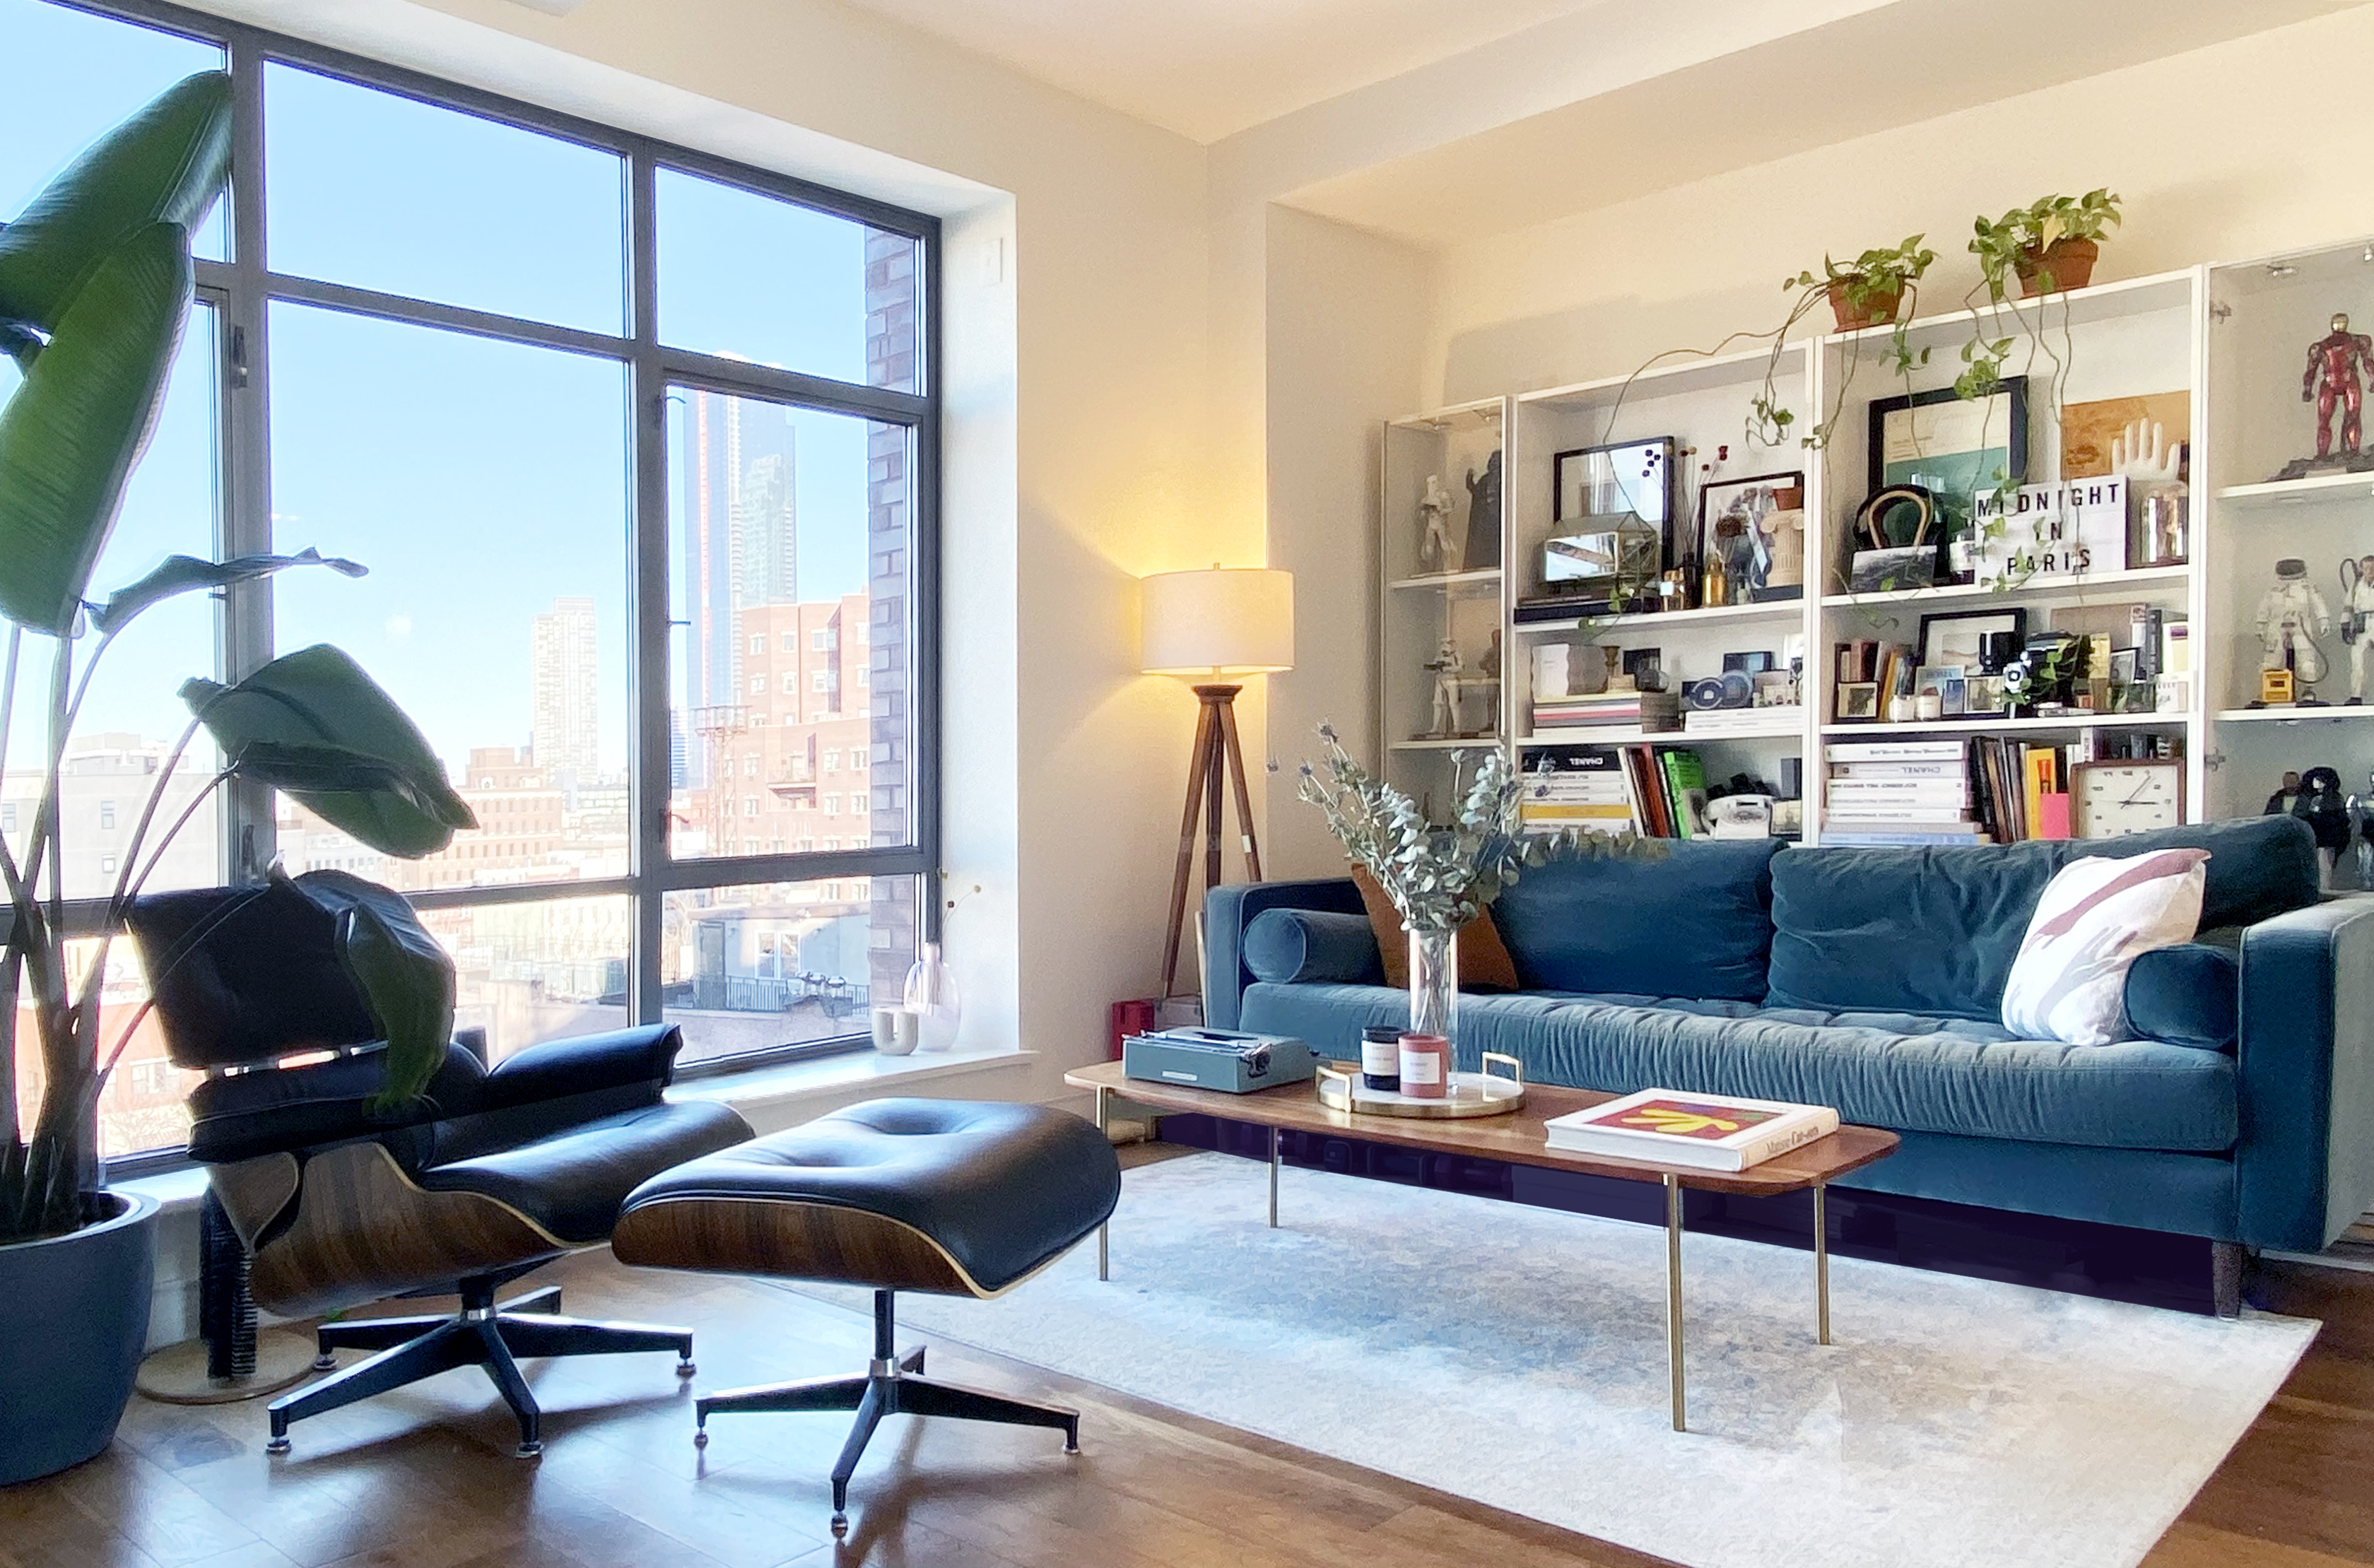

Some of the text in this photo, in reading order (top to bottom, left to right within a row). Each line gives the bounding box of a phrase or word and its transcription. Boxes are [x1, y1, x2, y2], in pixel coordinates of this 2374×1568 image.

[1978, 483, 2120, 517] MIDNIGHT
[2035, 522, 2062, 541] IN
[2007, 549, 2091, 575] PARIS
[1569, 757, 1604, 766] CHANEL
